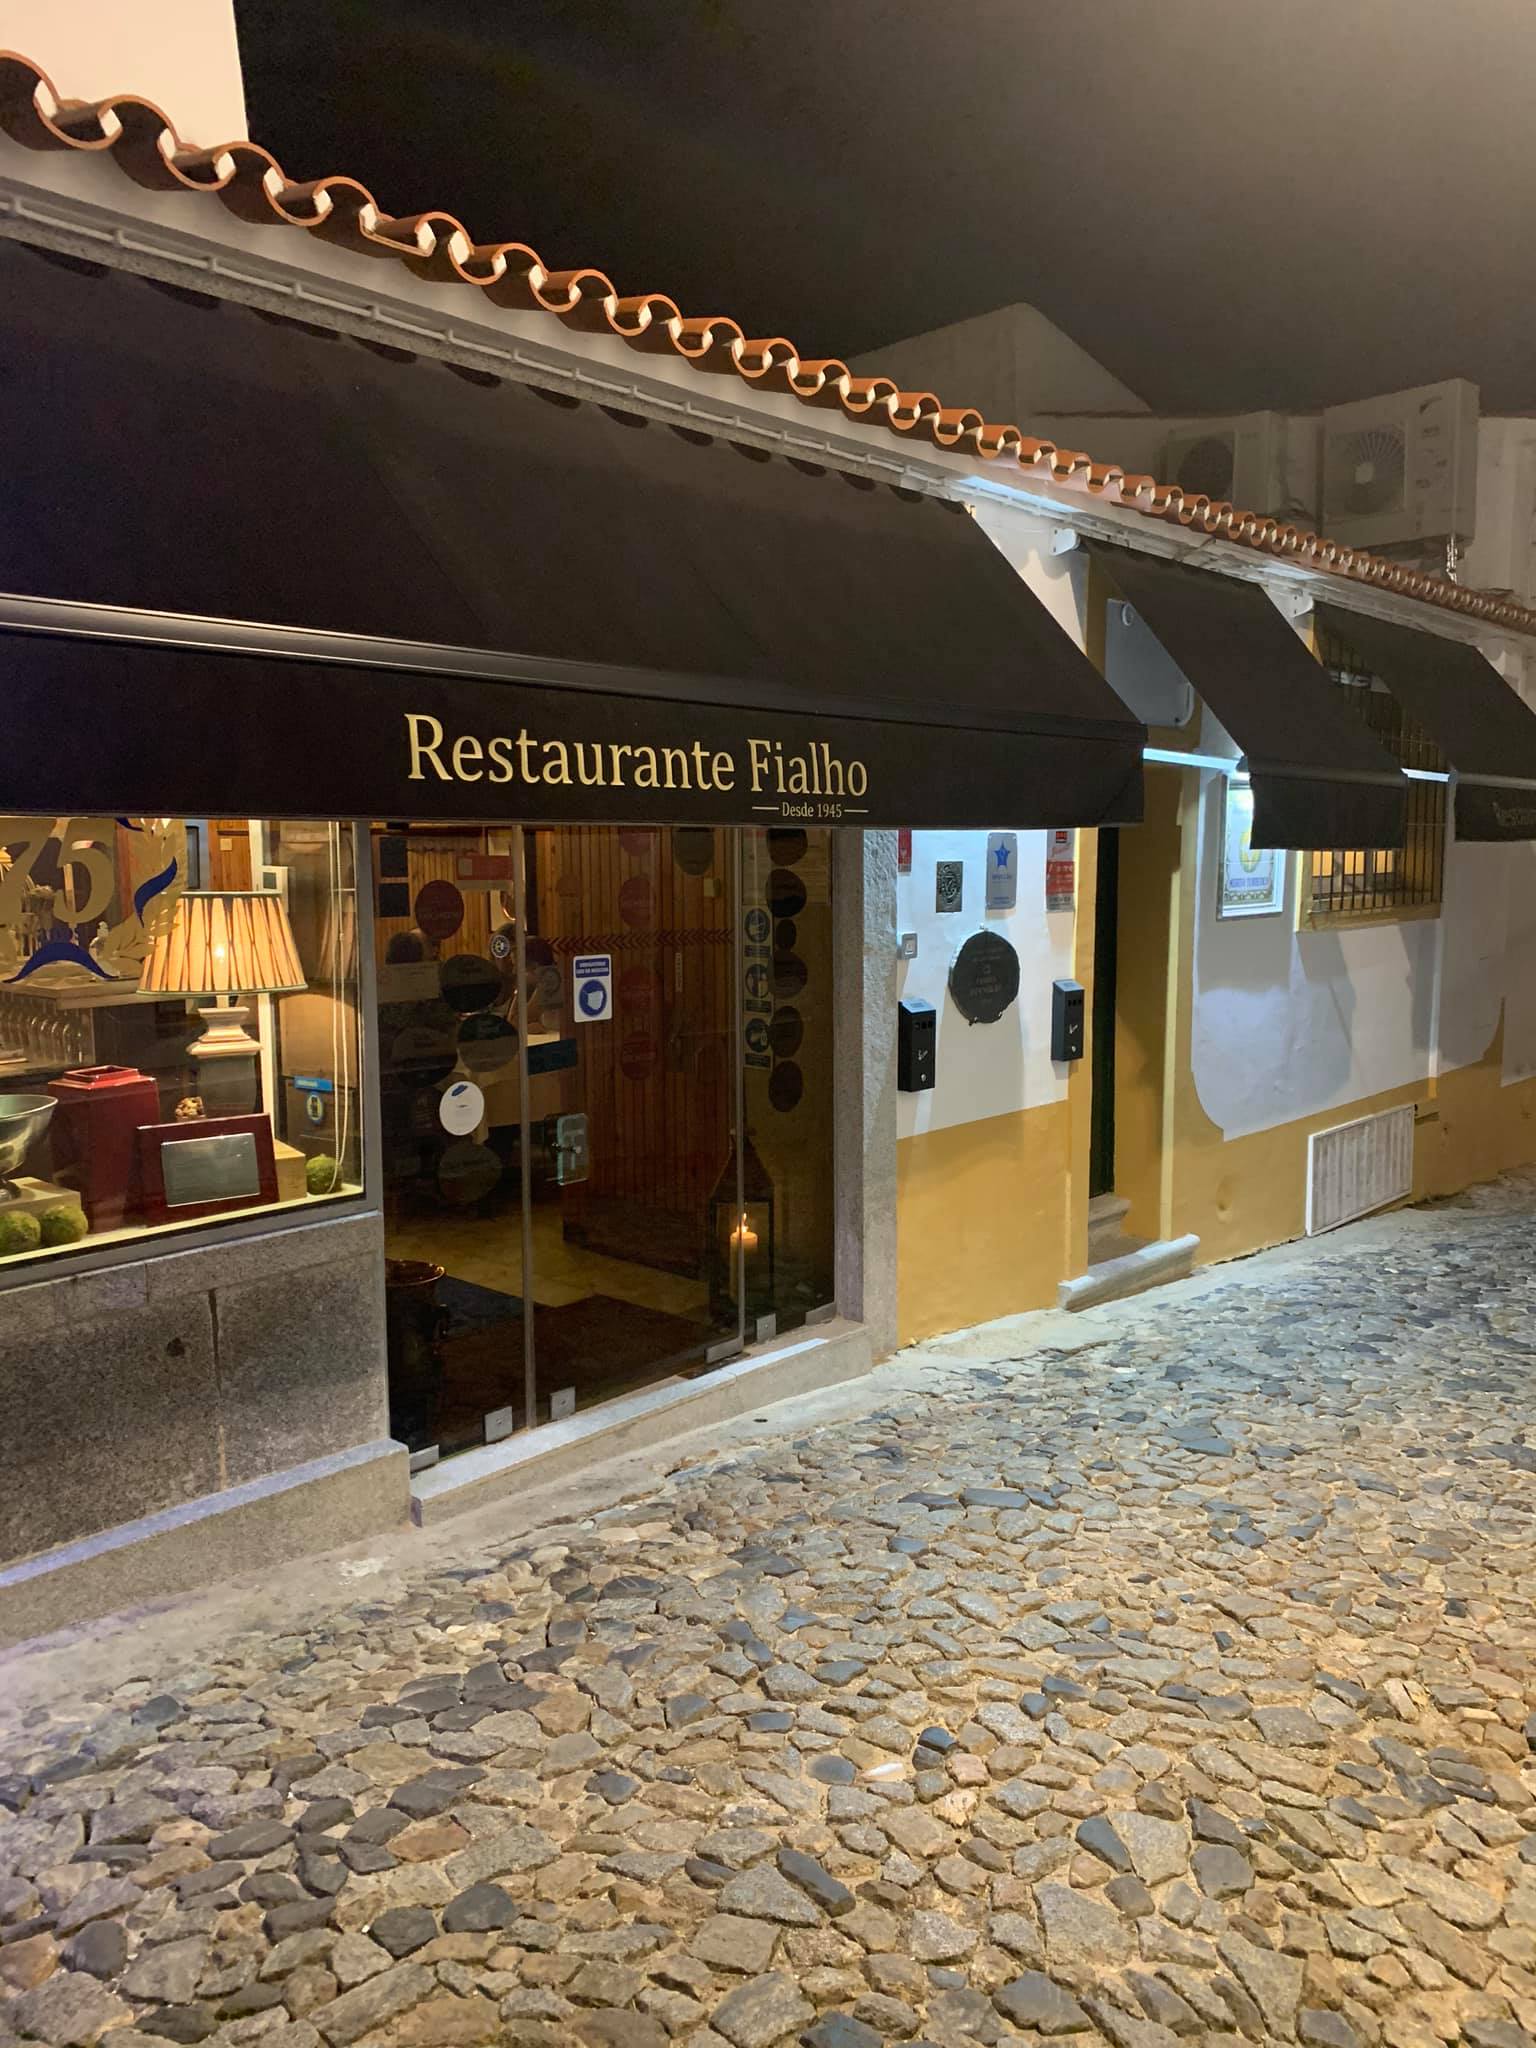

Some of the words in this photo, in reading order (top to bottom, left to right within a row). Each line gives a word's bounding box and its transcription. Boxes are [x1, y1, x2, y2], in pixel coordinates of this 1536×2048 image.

[403, 713, 735, 791] Restaurante
[746, 738, 868, 797] Fialho
[782, 801, 815, 818] Desde
[817, 803, 842, 818] 1945
